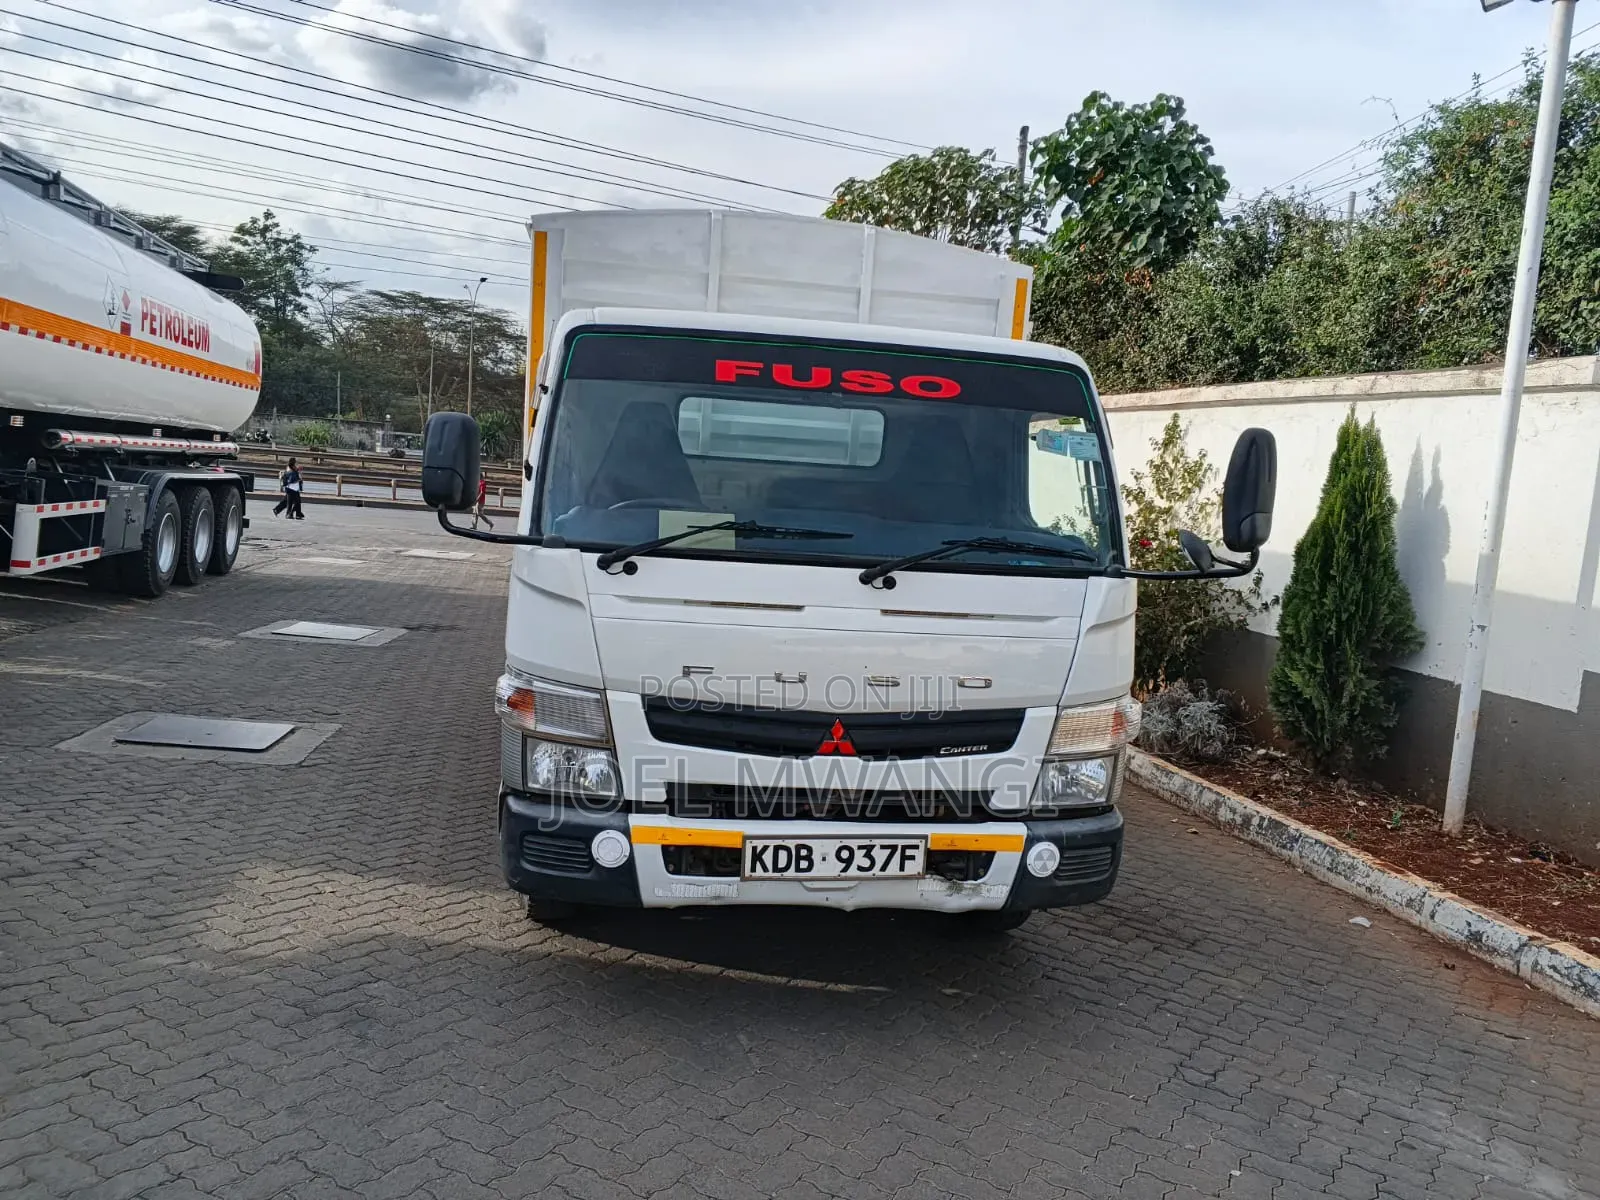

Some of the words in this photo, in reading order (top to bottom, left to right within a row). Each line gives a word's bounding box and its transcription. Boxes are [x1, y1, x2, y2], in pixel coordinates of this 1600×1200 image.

[140, 296, 210, 353] PETROLEUM
[715, 359, 962, 399] FUSO
[682, 665, 993, 689] FUSO
[750, 843, 815, 874] KDB
[834, 843, 920, 874] 937F
